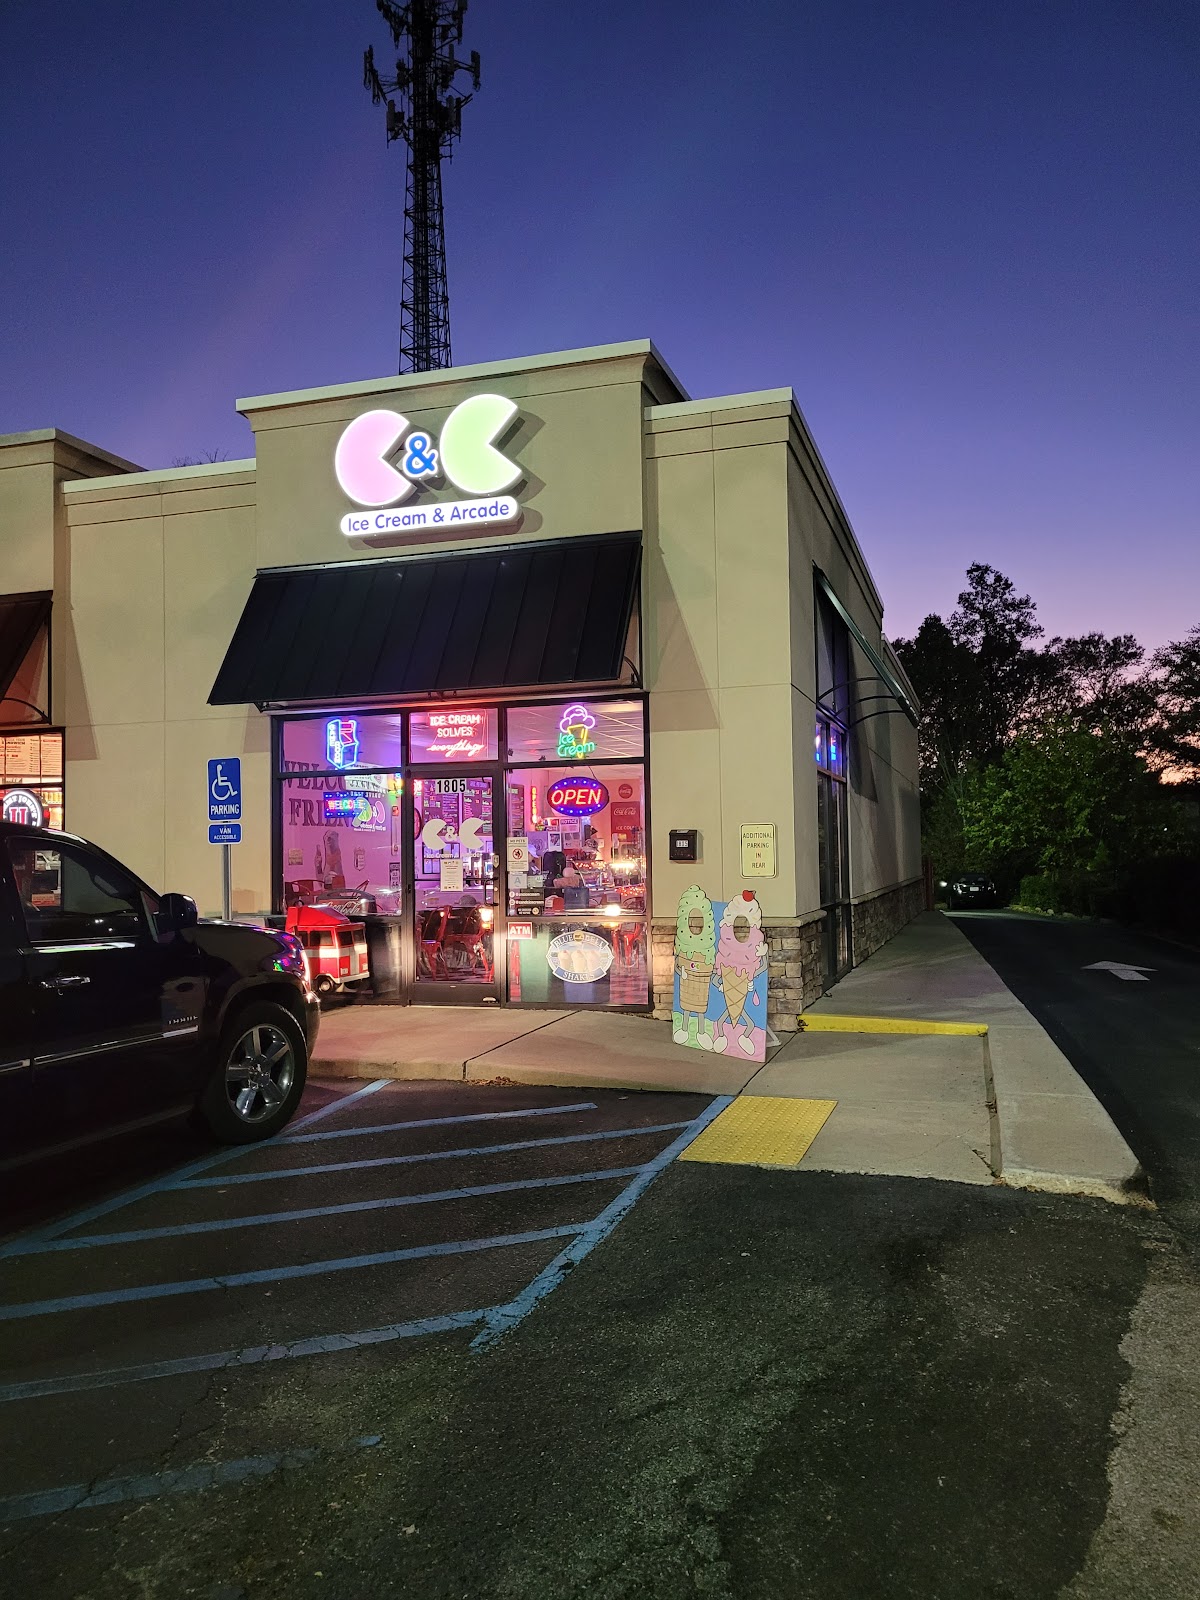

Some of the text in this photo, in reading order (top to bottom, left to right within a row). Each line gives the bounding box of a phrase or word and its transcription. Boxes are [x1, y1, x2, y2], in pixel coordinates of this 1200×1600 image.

[348, 500, 510, 533] Ice Cream & Arcade
[429, 714, 481, 727] ICE CREAM
[436, 726, 473, 738] SOLVES
[558, 733, 575, 745] Ice
[425, 738, 485, 758] everything
[557, 741, 596, 757] Cream
[436, 779, 466, 793] 1805
[550, 788, 602, 806] OPEN
[210, 803, 240, 815] PARKING
[509, 925, 532, 936] ATM
[553, 933, 574, 949] BLUE
